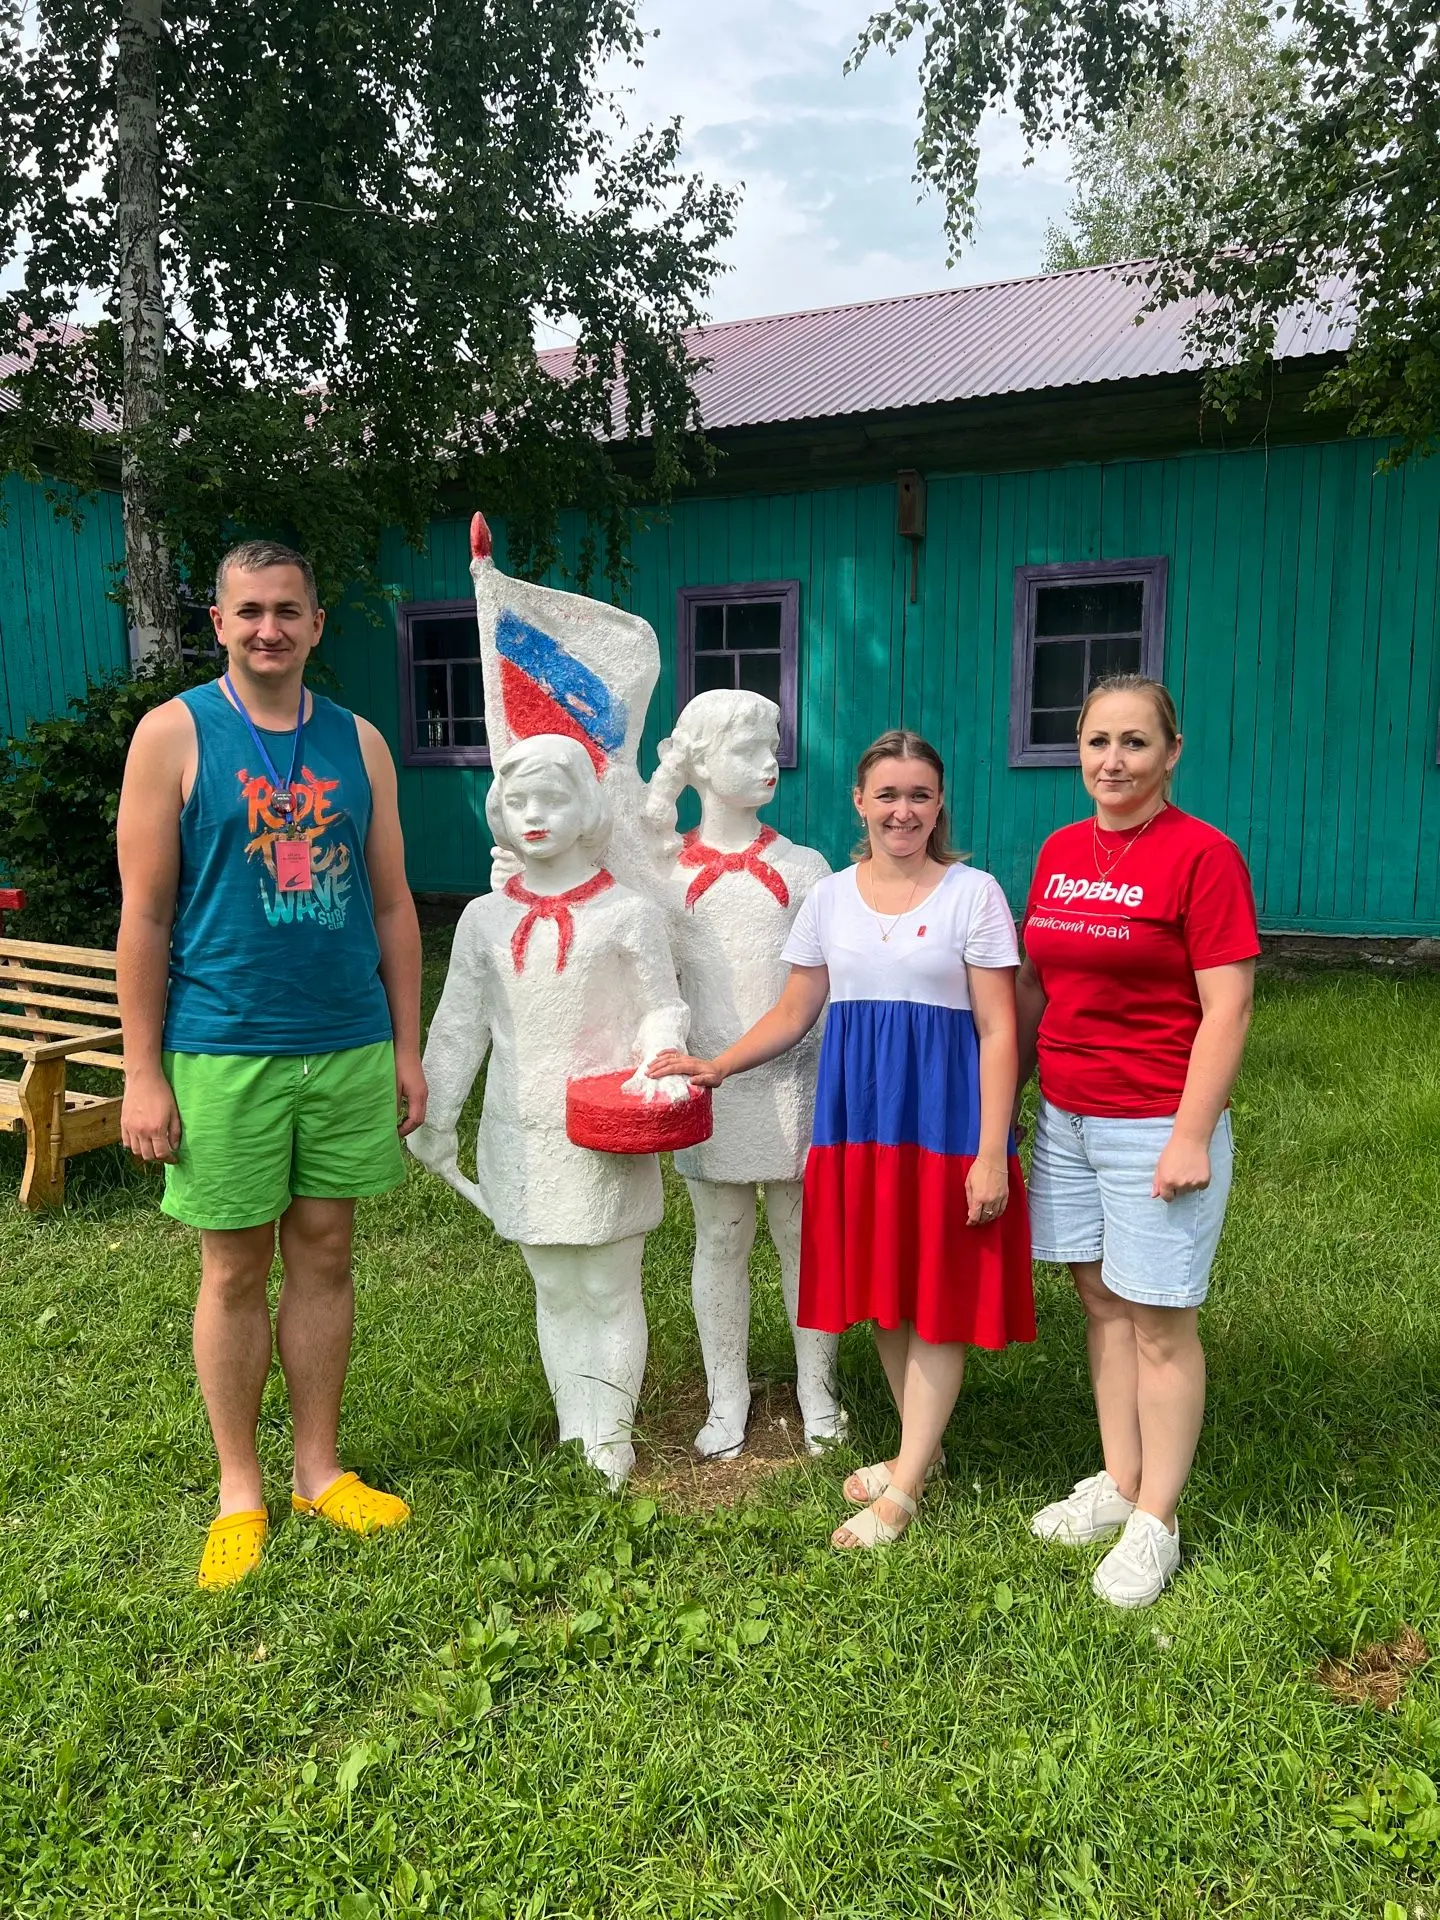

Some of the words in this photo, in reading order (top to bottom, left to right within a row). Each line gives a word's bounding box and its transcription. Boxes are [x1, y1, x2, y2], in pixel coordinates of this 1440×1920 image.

[236, 767, 340, 833] RDE
[245, 825, 338, 880] TE
[259, 874, 352, 927] WAVE
[1043, 873, 1144, 907] Первые
[318, 908, 347, 926] SURF
[1086, 923, 1130, 941] край
